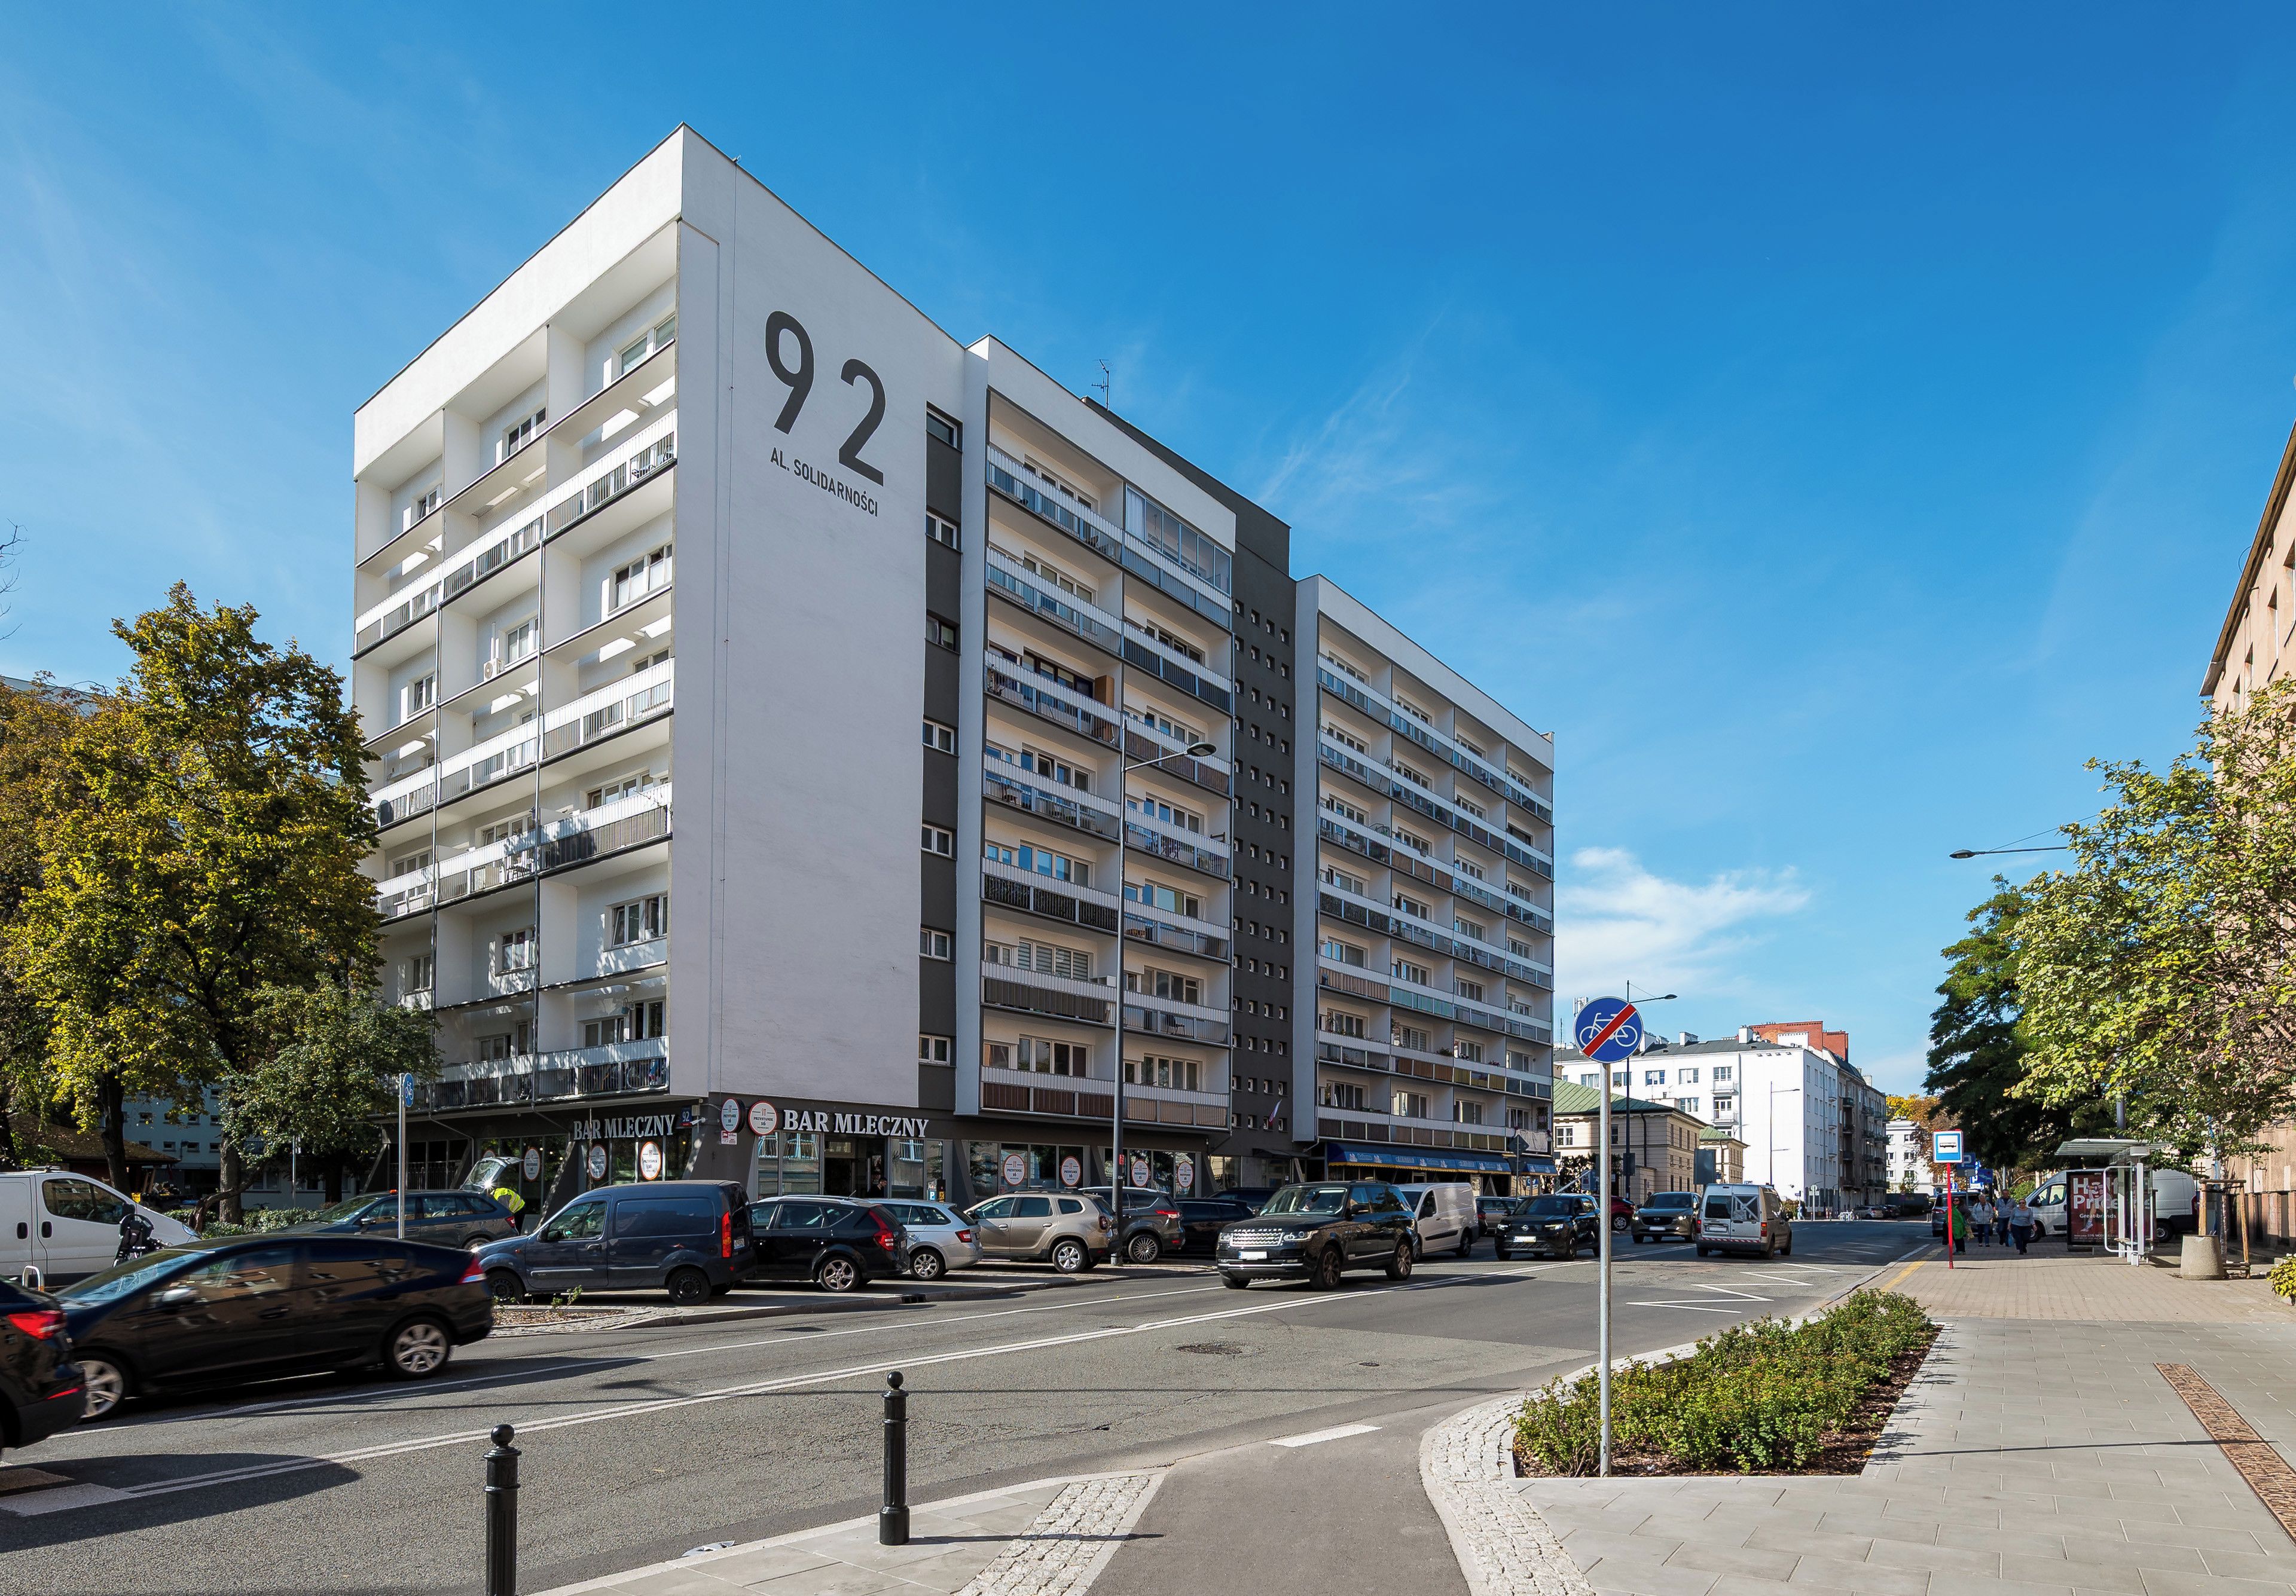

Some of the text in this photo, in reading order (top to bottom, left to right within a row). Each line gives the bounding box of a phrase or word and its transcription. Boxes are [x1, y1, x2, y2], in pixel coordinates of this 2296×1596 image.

[765, 311, 886, 487] 92
[770, 447, 878, 517] AL. SOLIDARNOŚCI
[573, 1114, 675, 1141] BAR MLECZNY
[682, 1111, 689, 1122] 92
[783, 1109, 929, 1138] BAR MLECZNY
